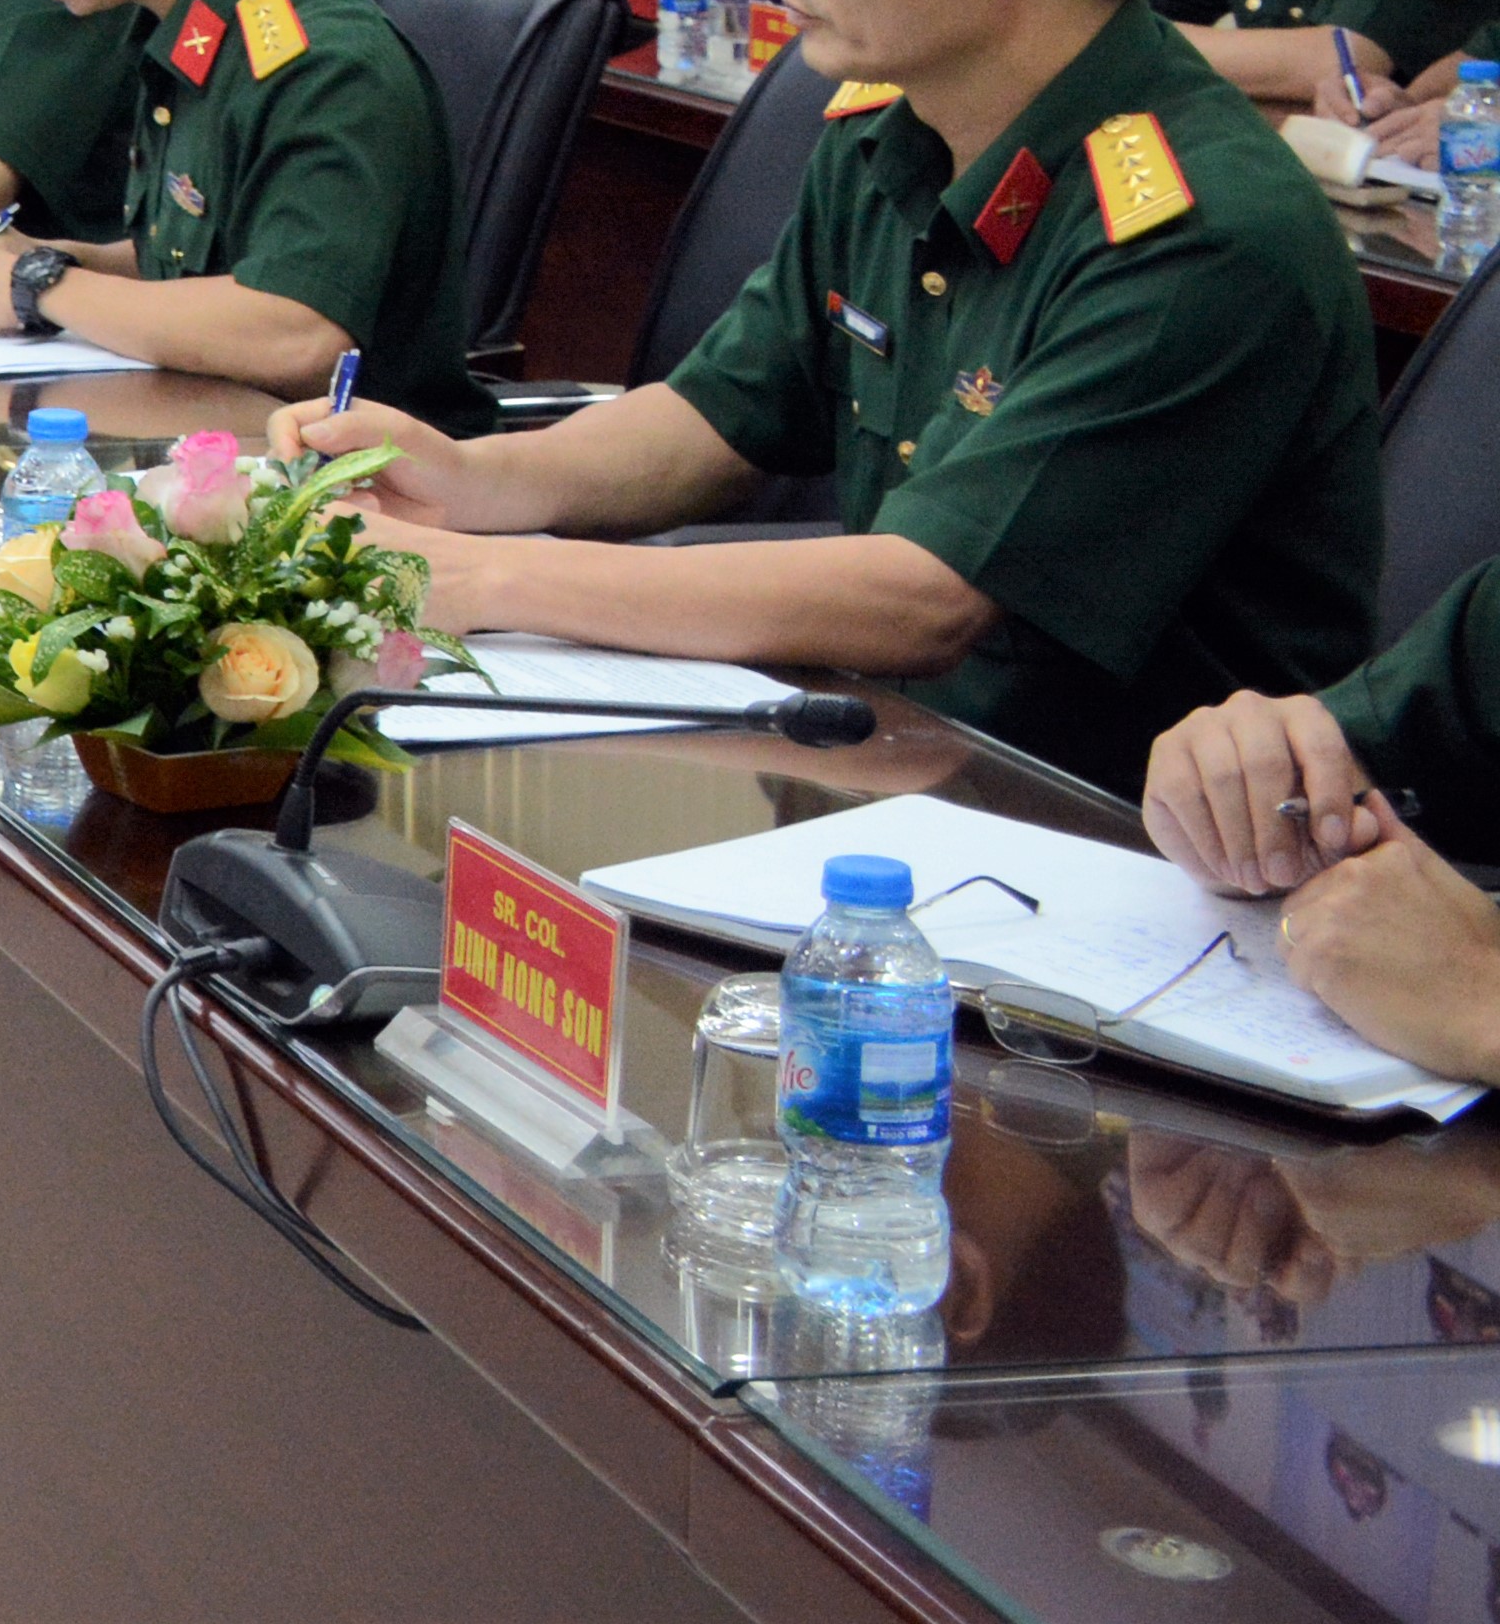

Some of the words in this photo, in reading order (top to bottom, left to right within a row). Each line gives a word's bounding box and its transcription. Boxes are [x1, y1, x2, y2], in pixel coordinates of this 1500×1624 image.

[493, 890, 519, 930] SR.
[525, 910, 566, 958] COL.
[453, 920, 498, 990] DINH
[502, 951, 556, 1028] HONG
[562, 989, 602, 1057] SON
